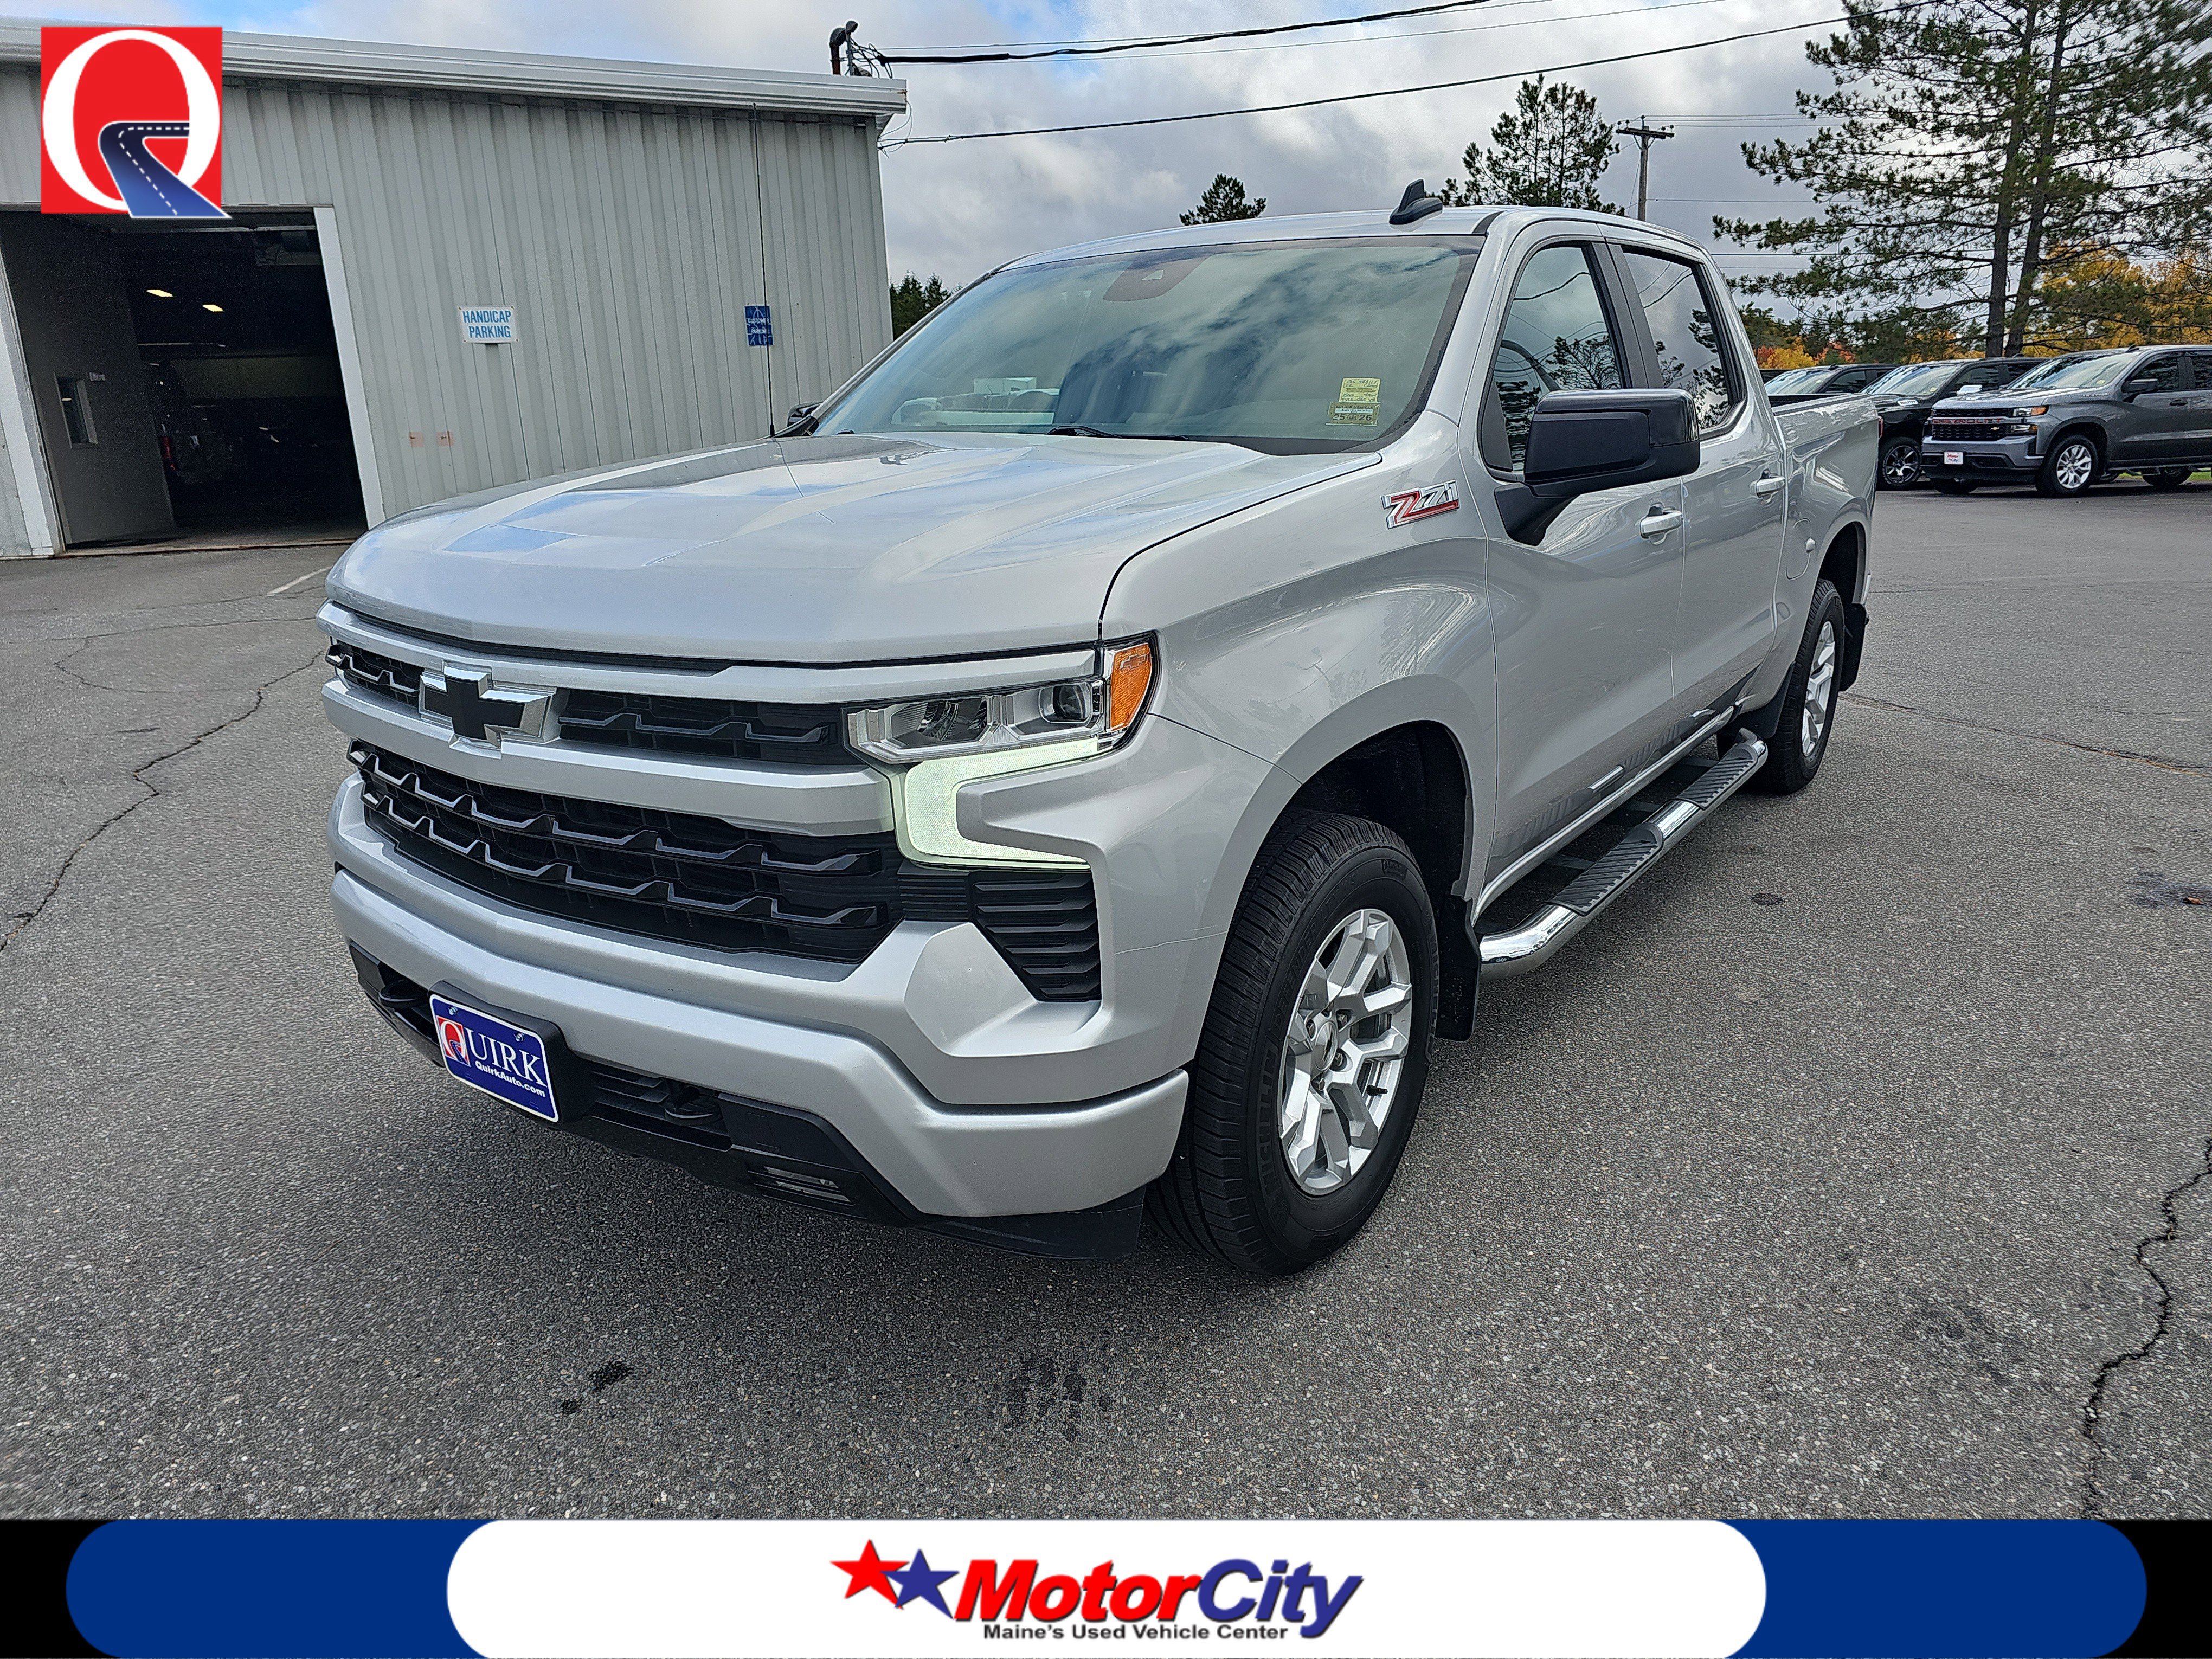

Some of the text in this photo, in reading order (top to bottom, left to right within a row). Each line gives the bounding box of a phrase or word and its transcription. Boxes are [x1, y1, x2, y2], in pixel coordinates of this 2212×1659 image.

[462, 310, 511, 323] HANDICAP
[468, 325, 511, 338] PARKING
[1381, 479, 1460, 529] Z71
[440, 1020, 548, 1088] QUIRK
[475, 1060, 546, 1097] QuirkAuto.com
[1257, 1047, 1278, 1196] MICHELIN
